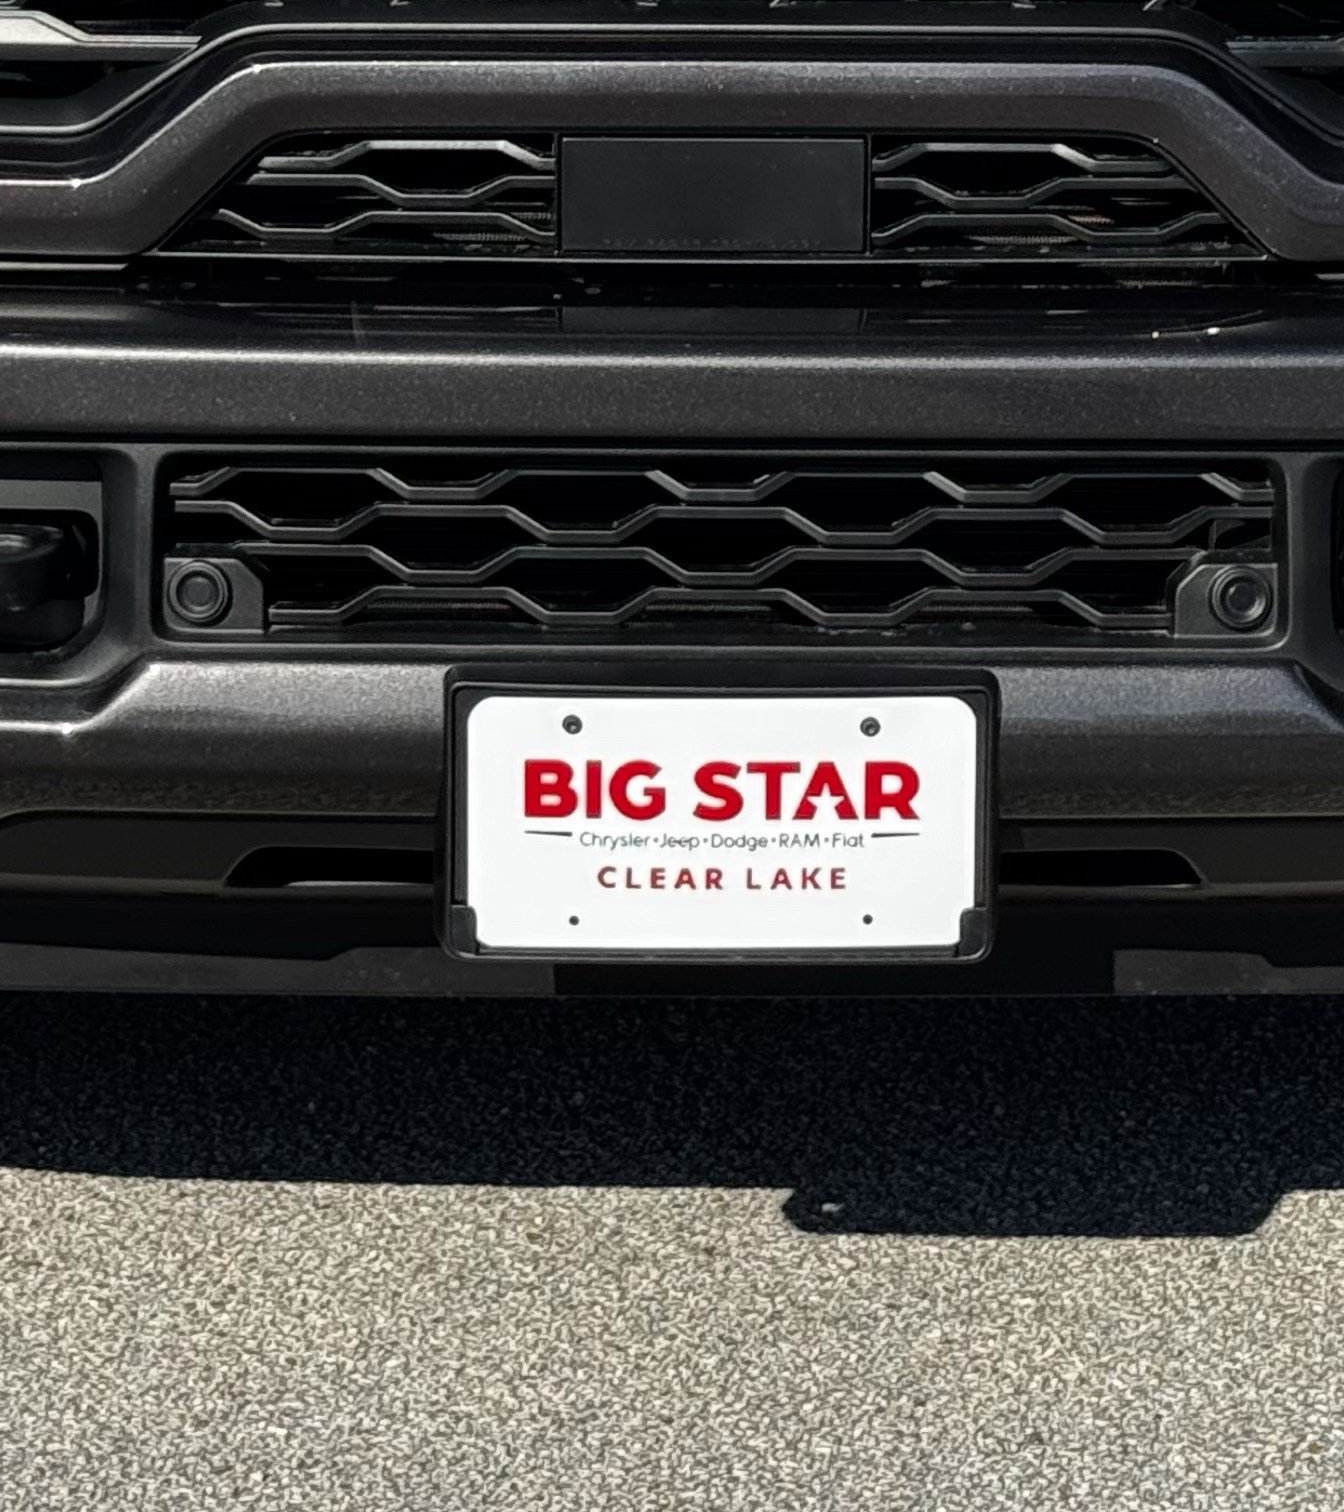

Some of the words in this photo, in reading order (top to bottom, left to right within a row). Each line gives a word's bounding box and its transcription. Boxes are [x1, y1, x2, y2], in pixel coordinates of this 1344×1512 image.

[523, 758, 667, 822] BIG
[692, 760, 921, 823] STAR
[596, 865, 724, 891] CLEAR
[745, 867, 846, 891] LAKE
